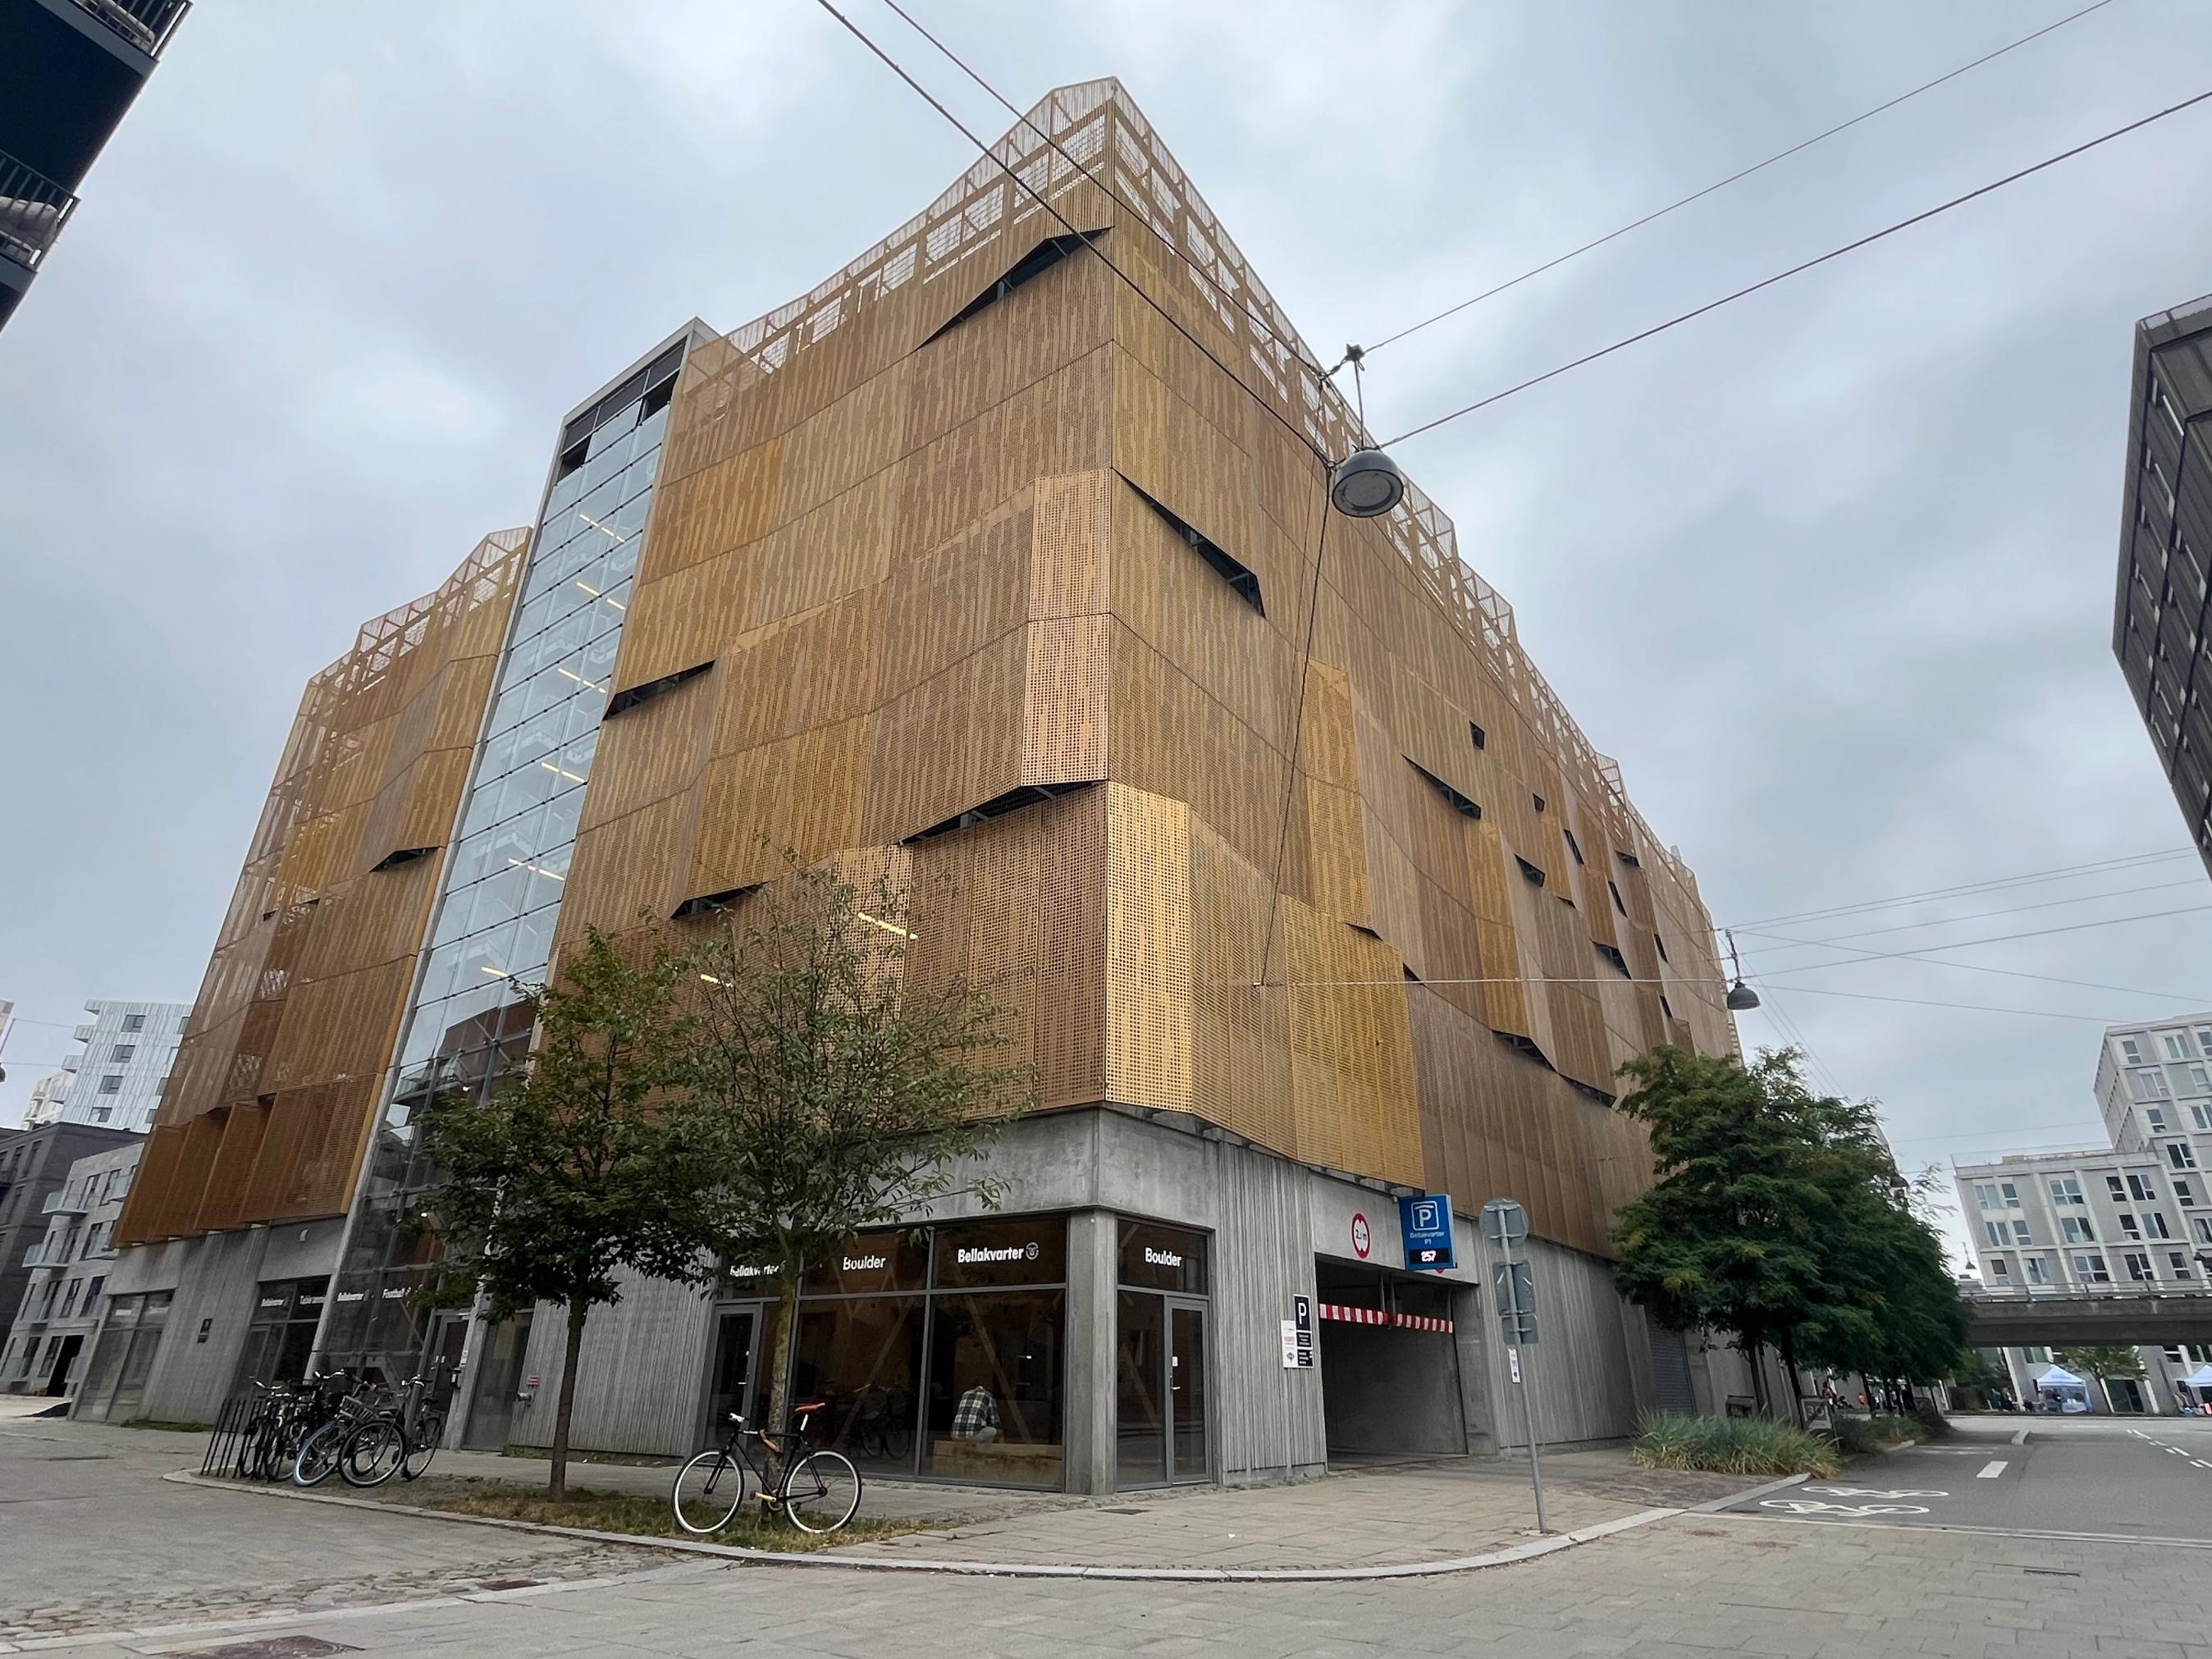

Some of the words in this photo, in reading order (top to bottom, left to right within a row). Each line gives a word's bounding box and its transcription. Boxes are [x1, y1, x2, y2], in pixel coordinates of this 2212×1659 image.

[1419, 1209, 1432, 1227] P
[843, 1255, 886, 1271] Boulder
[957, 1247, 1024, 1263] Bellakvarter
[1145, 1247, 1182, 1267] Boulder
[1421, 1250, 1437, 1262] 257
[729, 1264, 779, 1277] Bellakvrter
[1298, 1302, 1307, 1324] P
